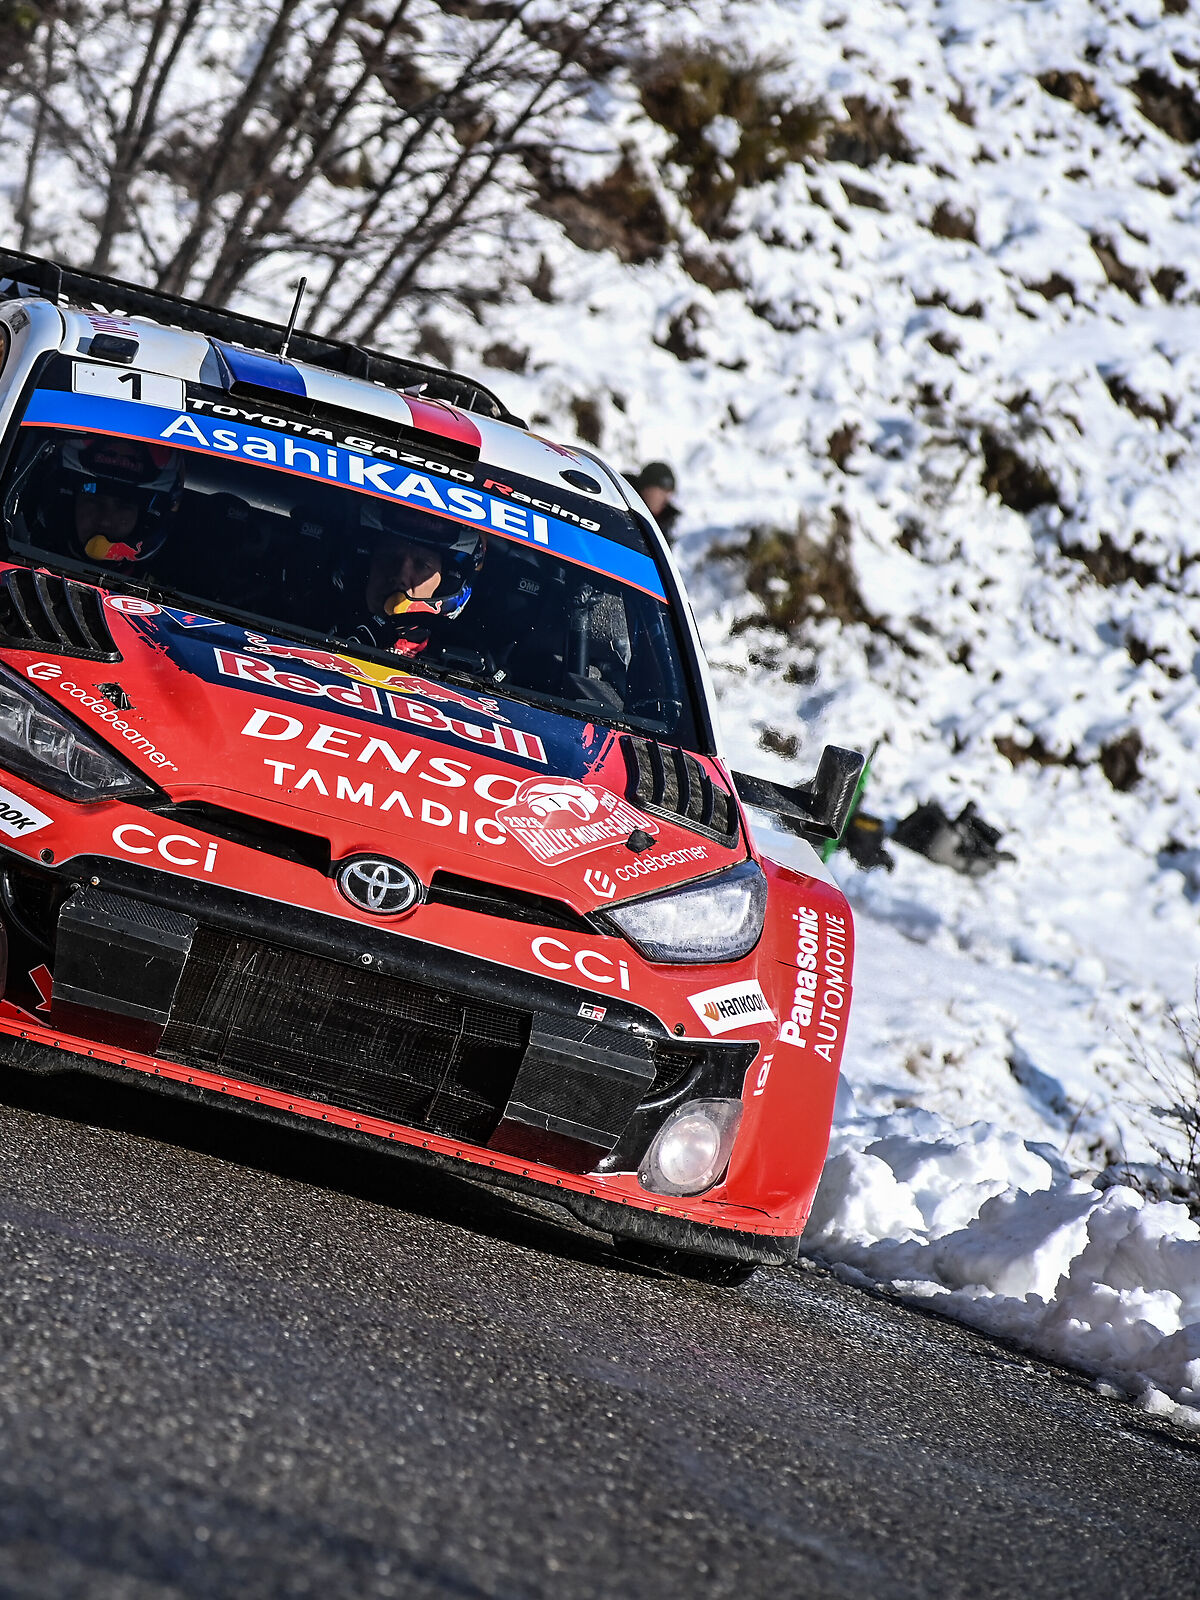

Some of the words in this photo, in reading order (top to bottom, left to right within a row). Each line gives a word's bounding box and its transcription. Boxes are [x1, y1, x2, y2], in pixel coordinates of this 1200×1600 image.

[118, 373, 141, 400] 1
[187, 398, 333, 440] TOYOTA
[343, 435, 475, 483] GAZOO
[483, 478, 601, 532] Racing
[122, 600, 144, 612] E
[518, 579, 540, 595] OMP
[213, 647, 382, 716] Red
[386, 691, 548, 765] Bull
[240, 707, 520, 807] DENSO
[263, 757, 507, 846] TAMADIC
[515, 828, 580, 860] RALLYE
[615, 845, 709, 882] codebeamer
[779, 906, 819, 1049] Panasonic
[814, 911, 846, 1063] AUTOMOTIVE
